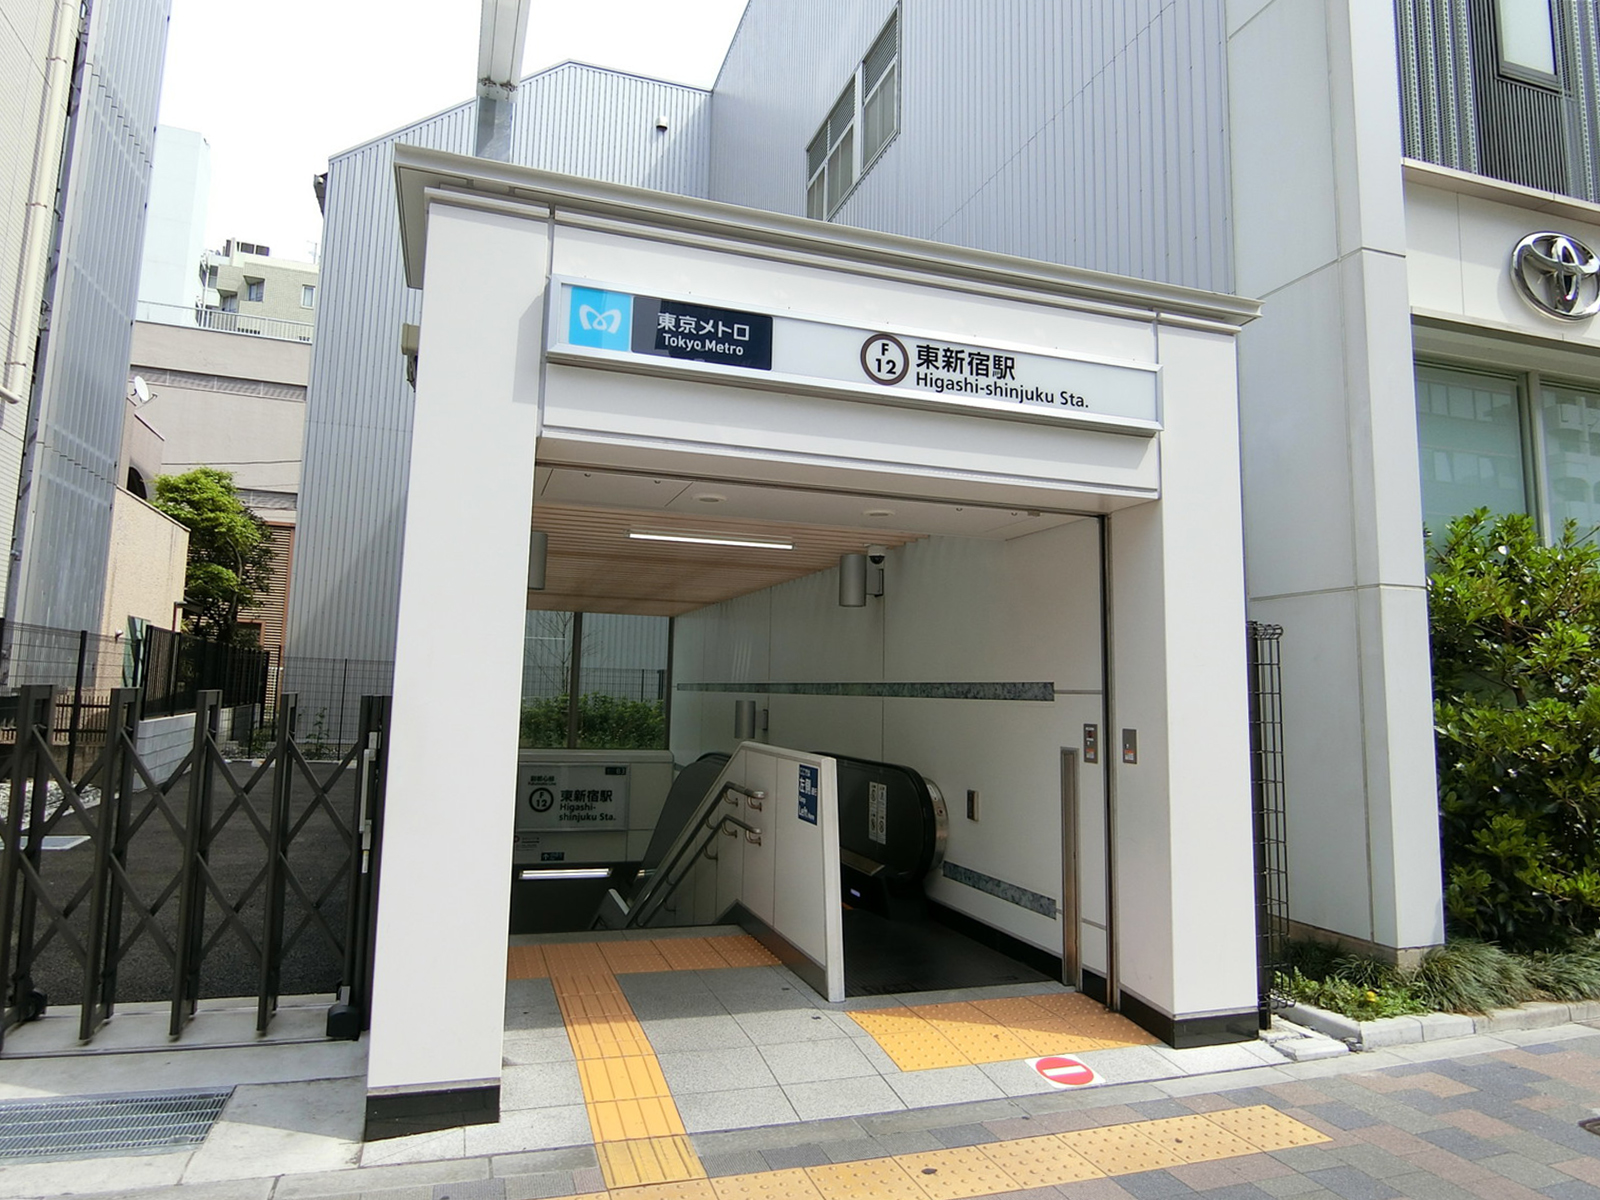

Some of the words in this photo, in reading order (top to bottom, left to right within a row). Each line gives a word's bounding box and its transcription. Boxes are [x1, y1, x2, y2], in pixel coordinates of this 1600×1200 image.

[657, 312, 750, 341] 東京メトロ
[663, 333, 702, 352] Tokyo
[705, 338, 744, 356] Metro
[881, 342, 890, 356] F
[875, 358, 897, 375] 12
[916, 343, 1017, 382] 東新宿駅
[916, 371, 1055, 404] Higashi-shinjuku
[1060, 390, 1090, 409] Sta.
[536, 799, 547, 807] 12
[560, 790, 613, 802] 東新宿駅
[560, 803, 596, 812] Higashi-
[559, 812, 598, 822] shinjuku
[600, 812, 616, 821] Sta.
